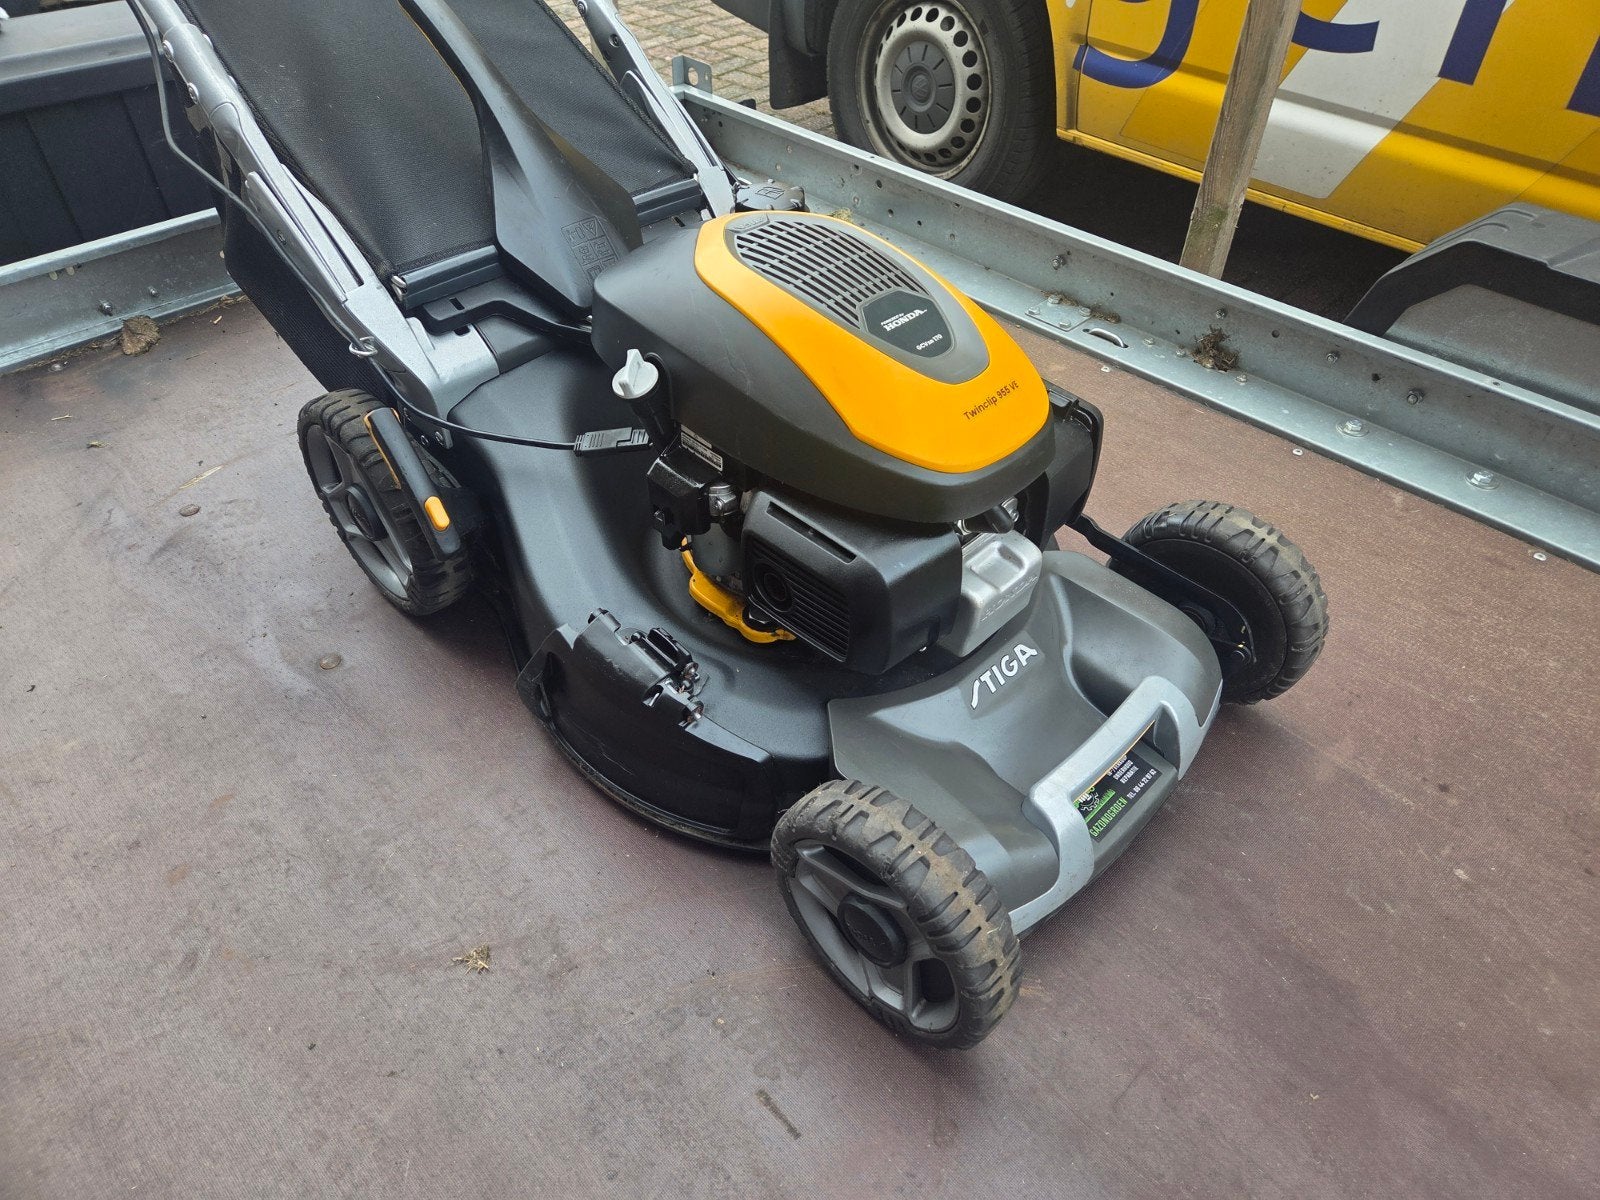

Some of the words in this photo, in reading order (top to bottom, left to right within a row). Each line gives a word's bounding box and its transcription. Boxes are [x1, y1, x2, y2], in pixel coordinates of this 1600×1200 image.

[883, 309, 928, 331] HONDA
[963, 396, 997, 420] Twinclip
[996, 386, 1010, 400] 955
[1009, 380, 1019, 391] VE
[970, 642, 1038, 710] STIGA
